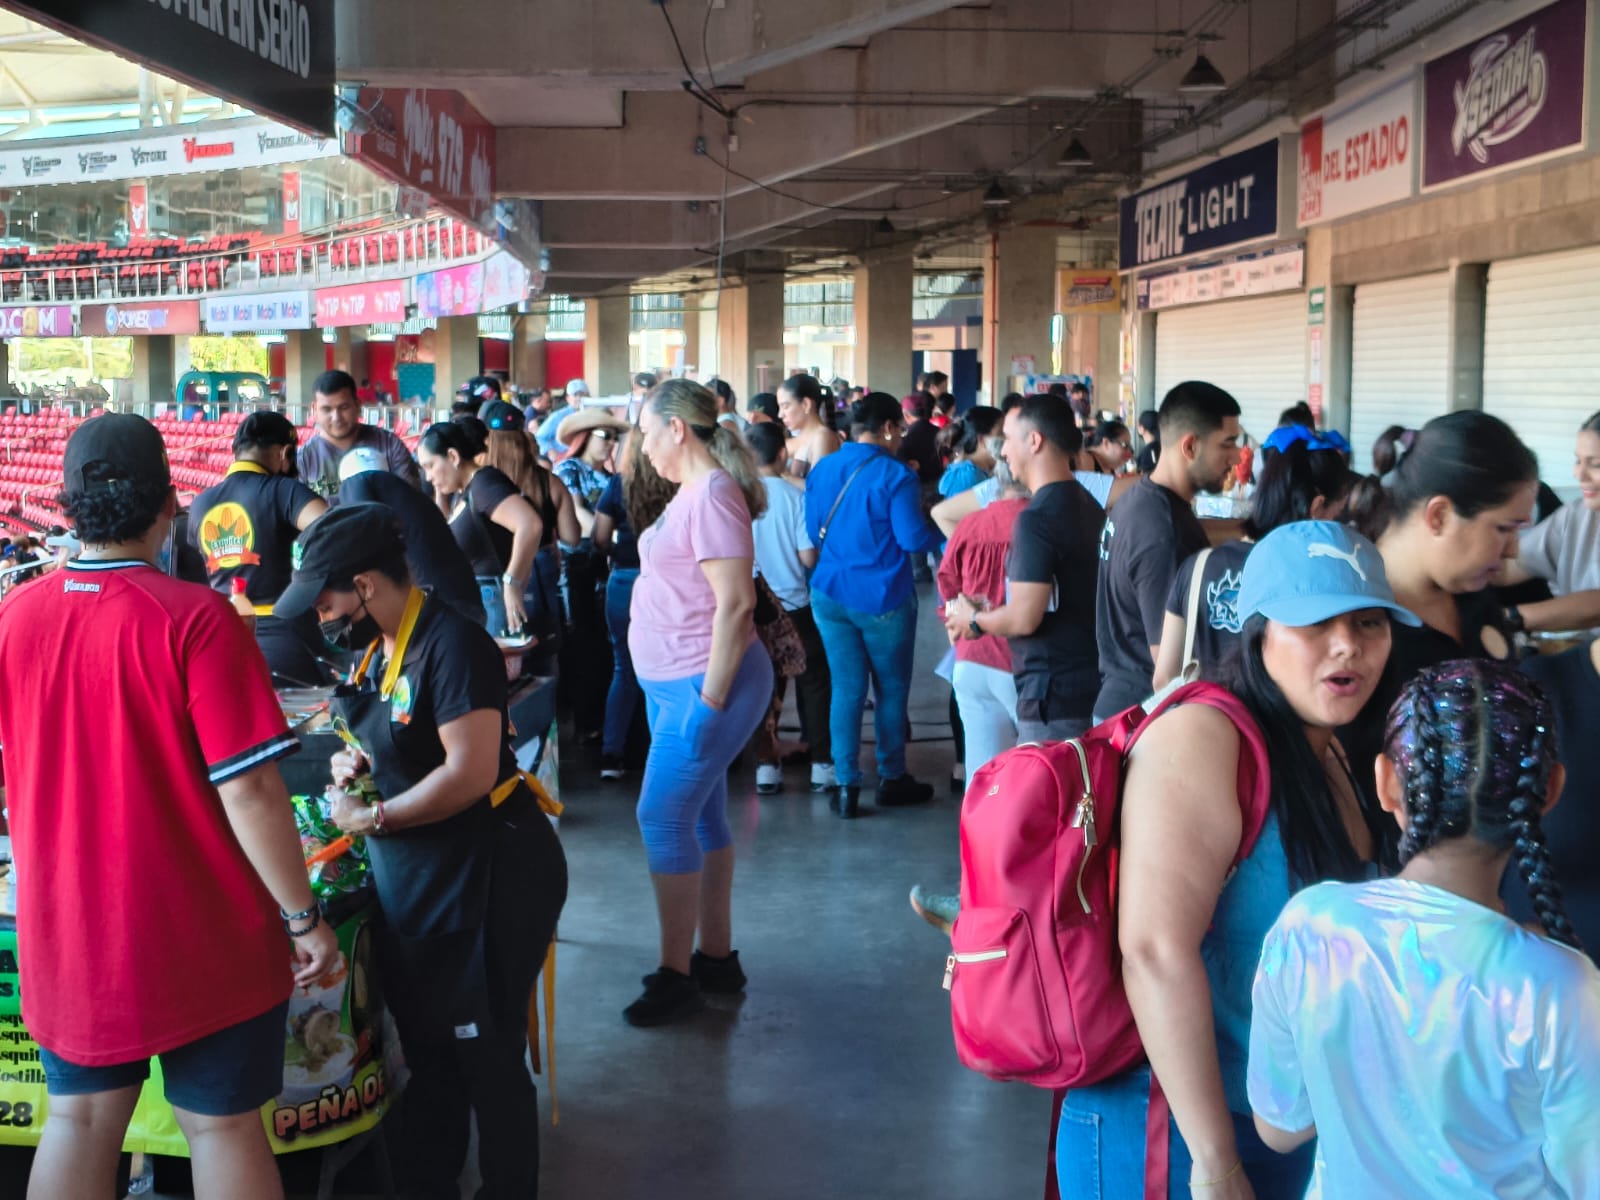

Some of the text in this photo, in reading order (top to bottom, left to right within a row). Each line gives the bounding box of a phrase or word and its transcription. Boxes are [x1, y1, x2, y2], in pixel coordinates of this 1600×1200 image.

[257, 0, 311, 79] SERIO
[1323, 114, 1409, 184] DEL ESTADIO
[1134, 180, 1188, 264] TECATE
[1187, 174, 1255, 235] LIGHT
[0, 1031, 33, 1045] squ
[0, 1048, 40, 1065] squit
[0, 1068, 46, 1083] ostill
[274, 1085, 359, 1137] PEÑA
